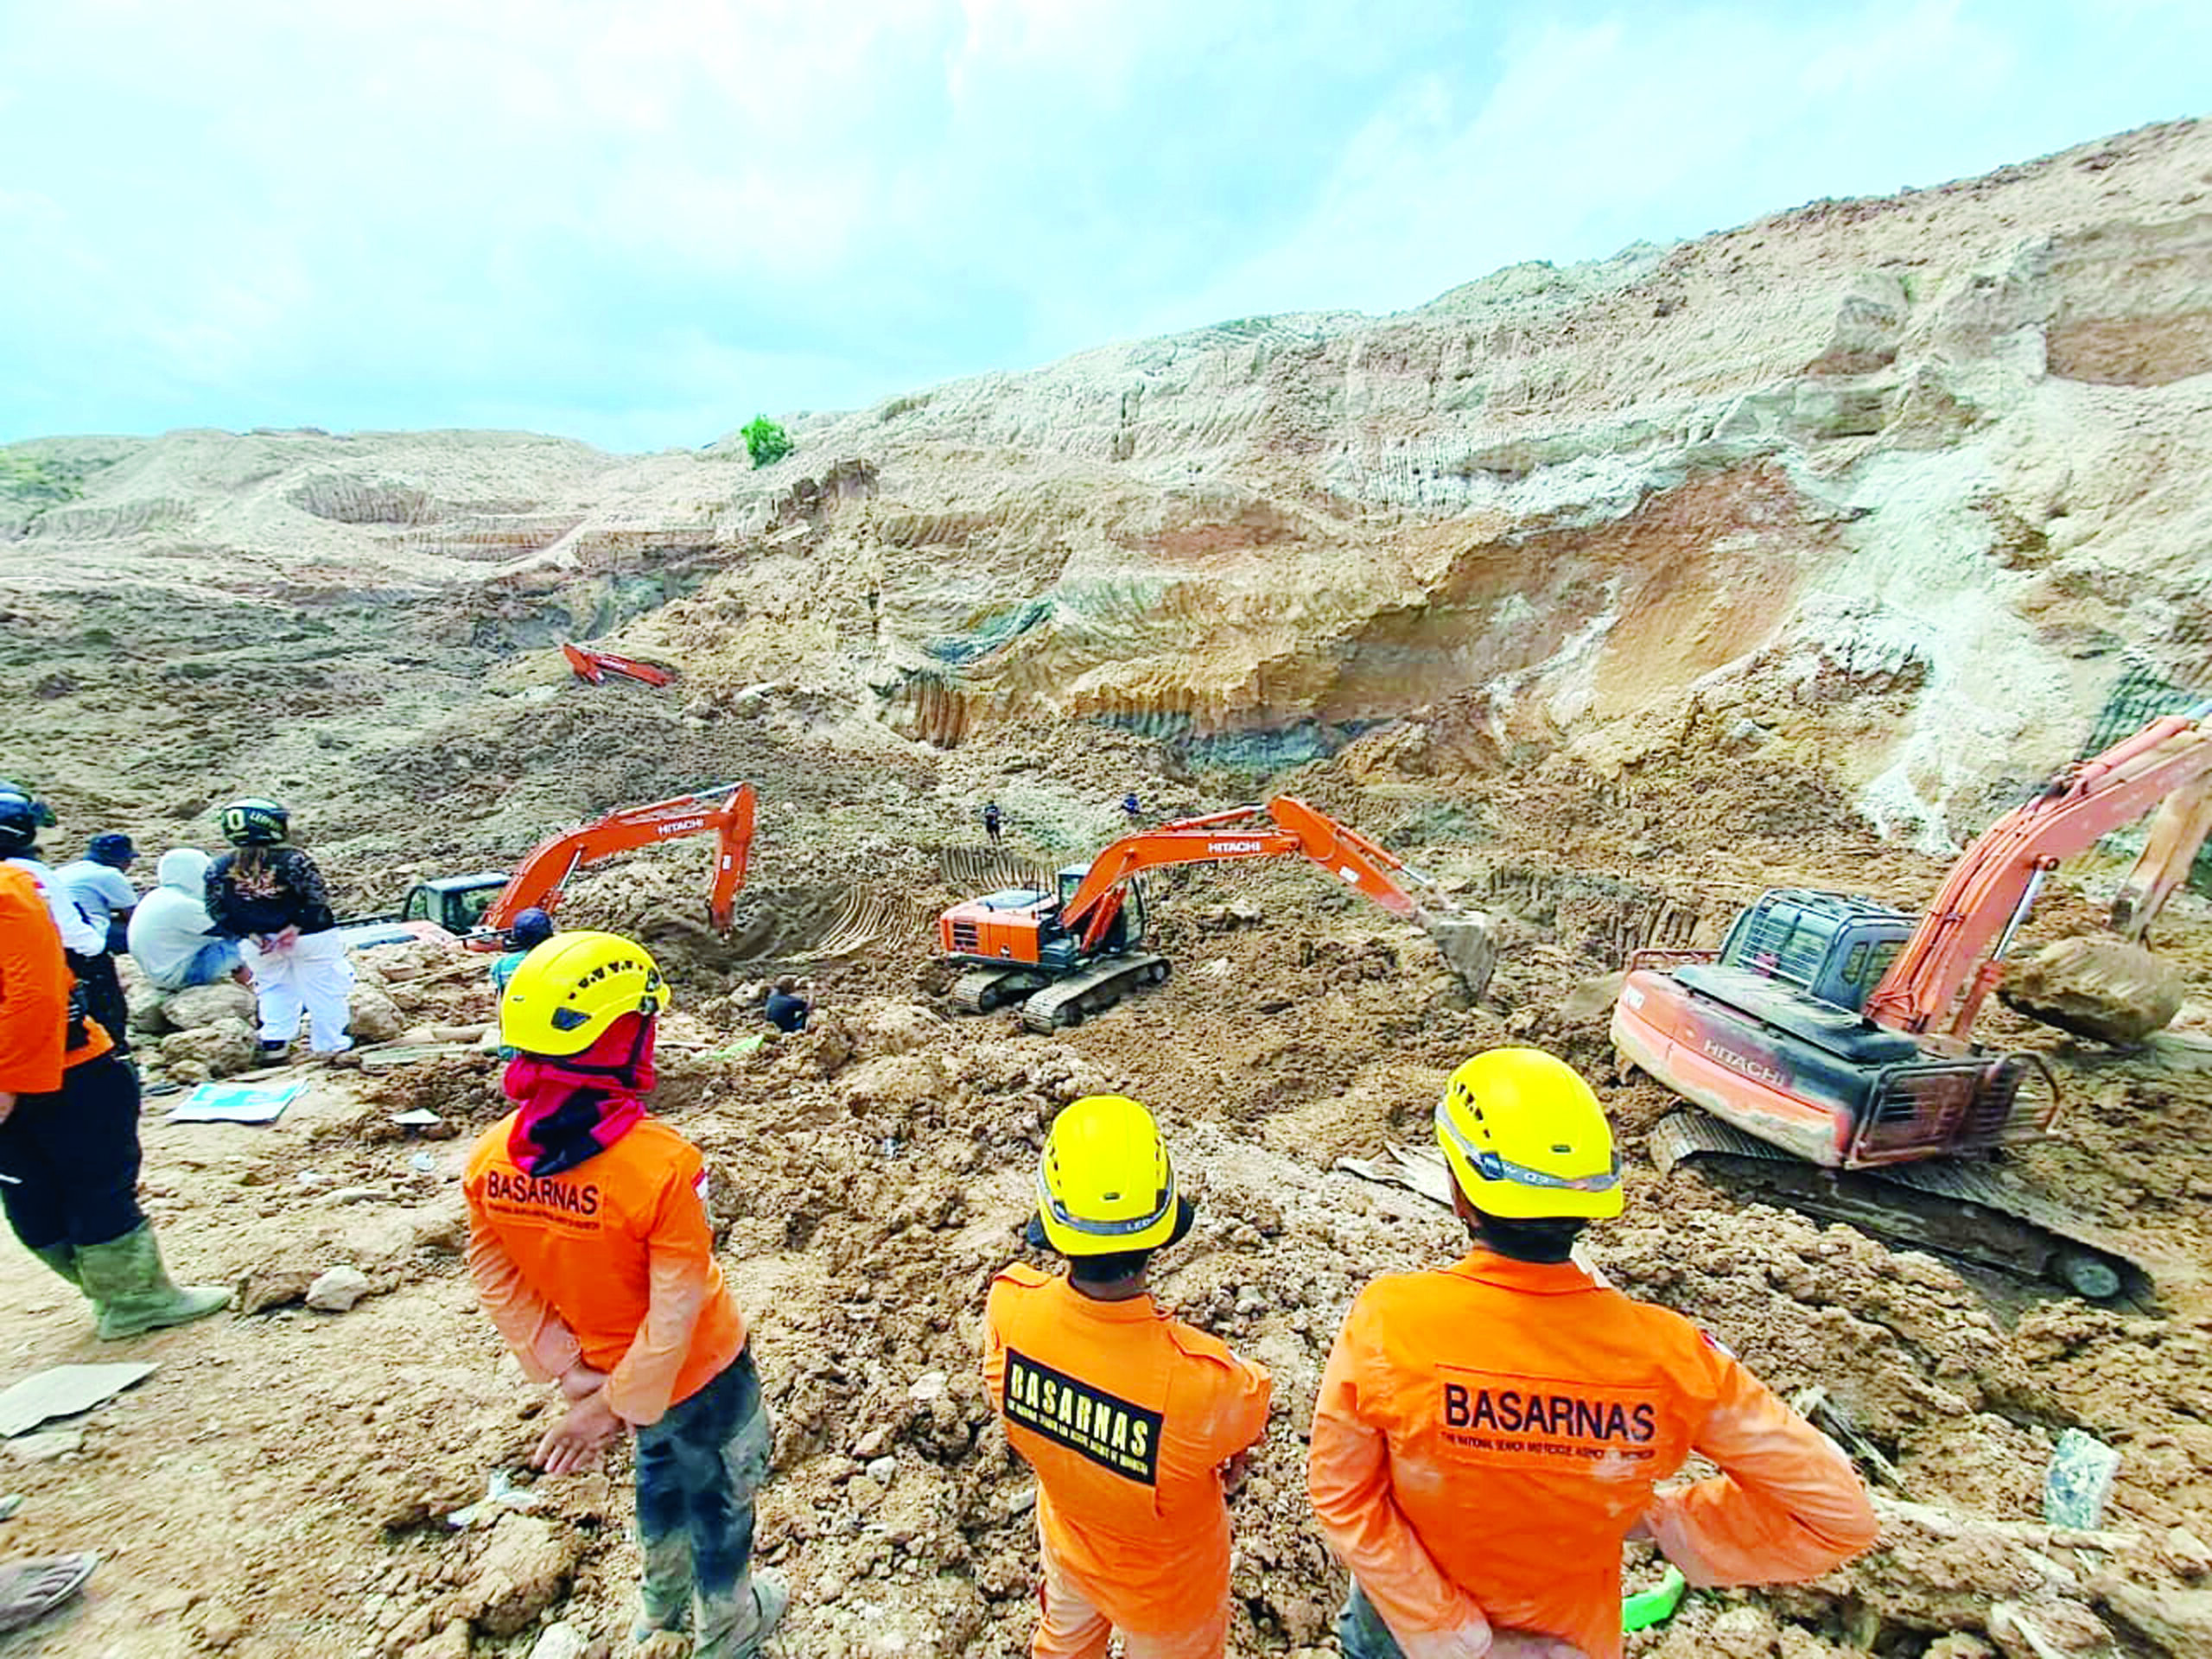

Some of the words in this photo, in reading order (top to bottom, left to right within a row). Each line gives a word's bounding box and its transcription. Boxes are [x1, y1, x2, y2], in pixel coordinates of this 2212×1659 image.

[658, 818, 704, 836] HITACHI
[1207, 842, 1260, 854] HITACHI
[1703, 1039, 1785, 1086] HITACHI
[488, 1170, 599, 1215] BASARNAS
[1010, 1363, 1148, 1458] BASARNAS
[1445, 1382, 1656, 1442] BASARNAS
